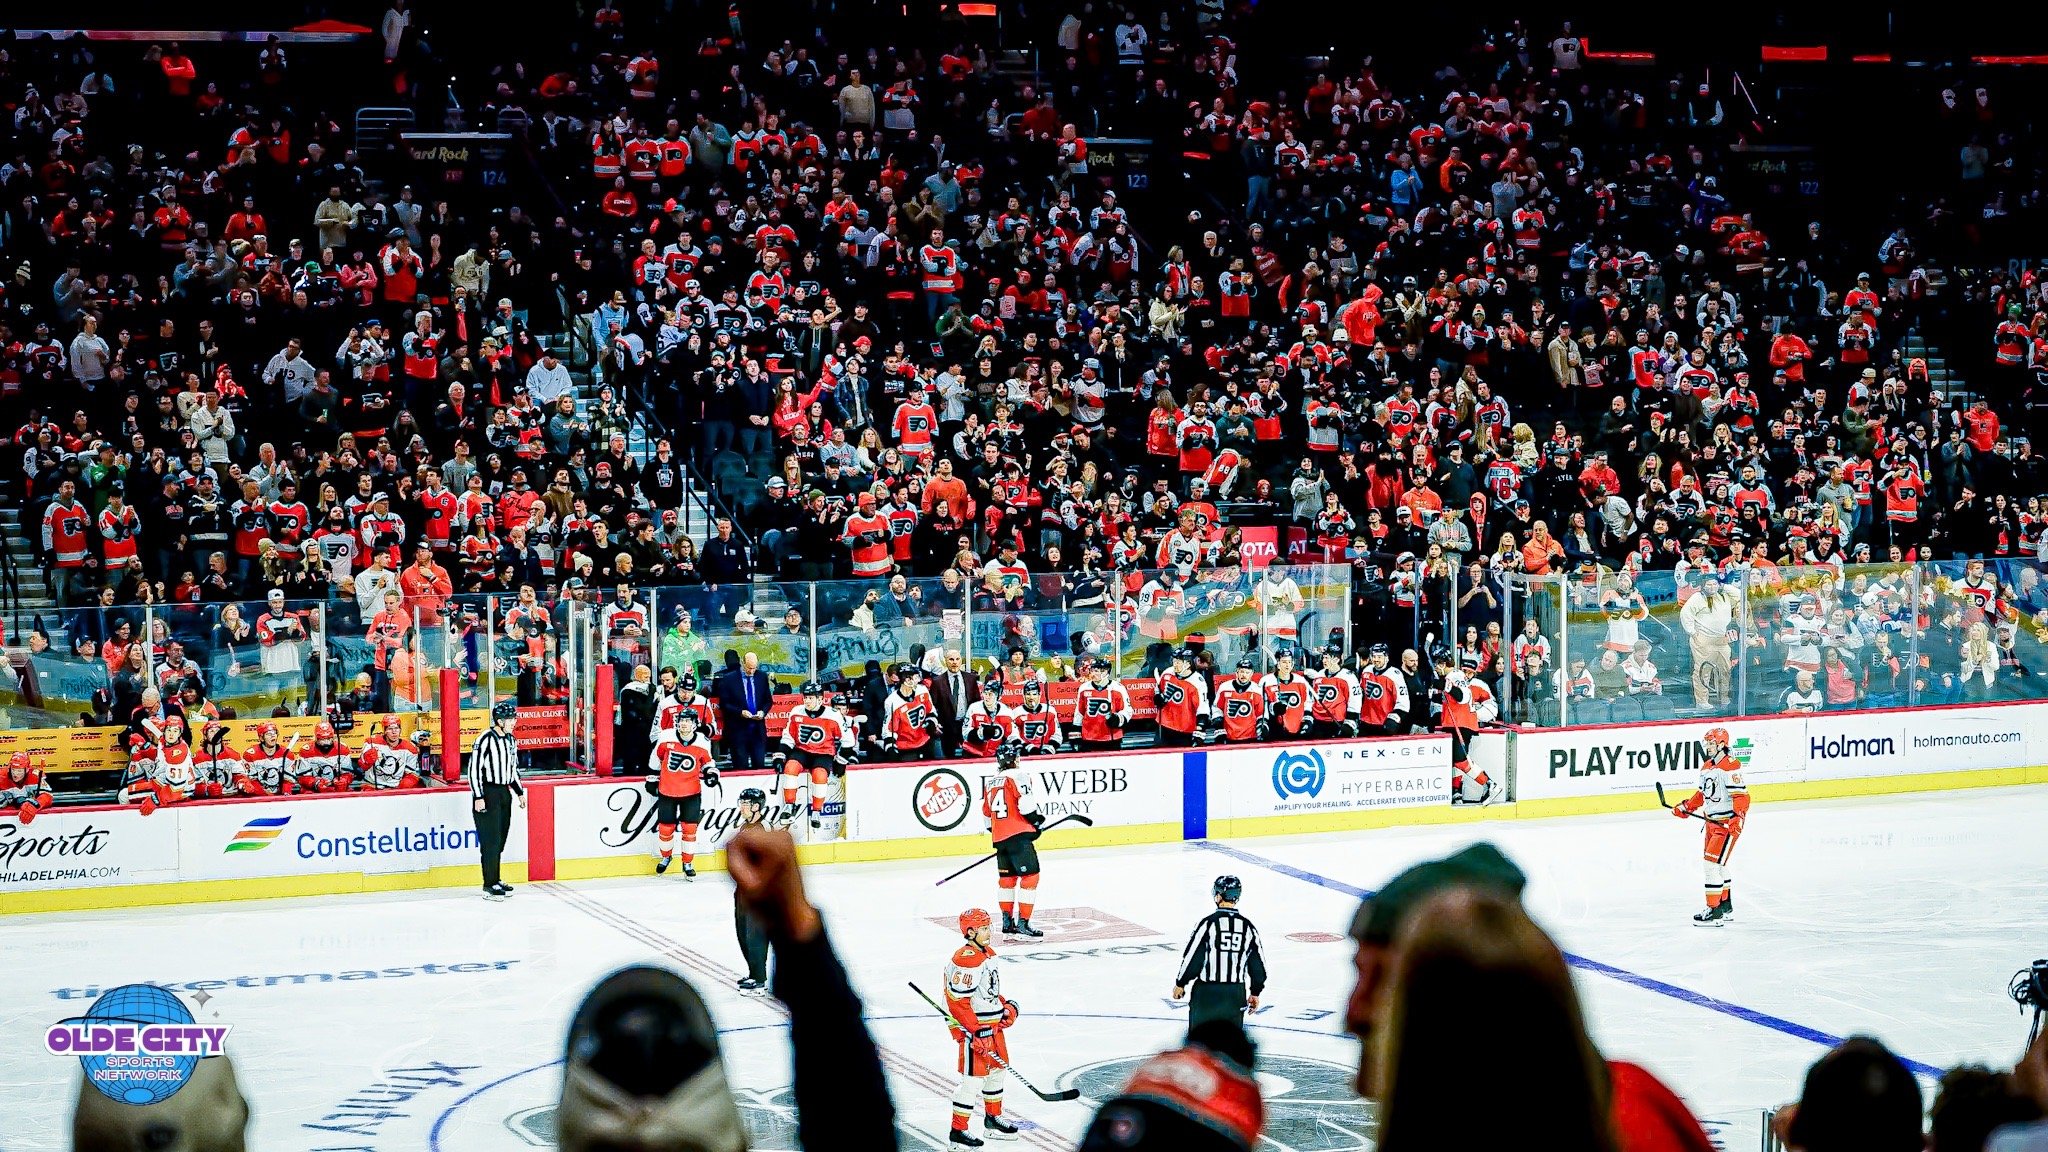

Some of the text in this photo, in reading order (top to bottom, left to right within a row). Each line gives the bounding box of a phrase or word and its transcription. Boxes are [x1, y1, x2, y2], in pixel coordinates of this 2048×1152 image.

[410, 147, 469, 163] ard Rock
[1088, 151, 1115, 167] Rock
[482, 170, 507, 186] 124
[1127, 174, 1148, 188] 123
[543, 736, 570, 744] CLOSETS
[1811, 731, 2021, 760] Holman holmanauto.com
[1549, 745, 1623, 779] PLAY
[1626, 750, 1651, 769] TO
[170, 768, 183, 779] 51
[1040, 768, 1128, 797] WEBB
[1342, 777, 1443, 794] HYPERBARIC
[926, 786, 959, 814] WEBB
[1274, 803, 1301, 811] AMPLIFY
[1303, 802, 1321, 810] YOUR
[1323, 800, 1353, 808] HEALING.
[1357, 797, 1397, 806] ACCELERATE
[820, 804, 844, 814] IGHT
[297, 824, 480, 858] Constellation
[1220, 932, 1242, 951] 59
[999, 942, 1180, 963] TOYOT
[48, 959, 522, 1000] tiketmaster
[952, 971, 973, 988] 64
